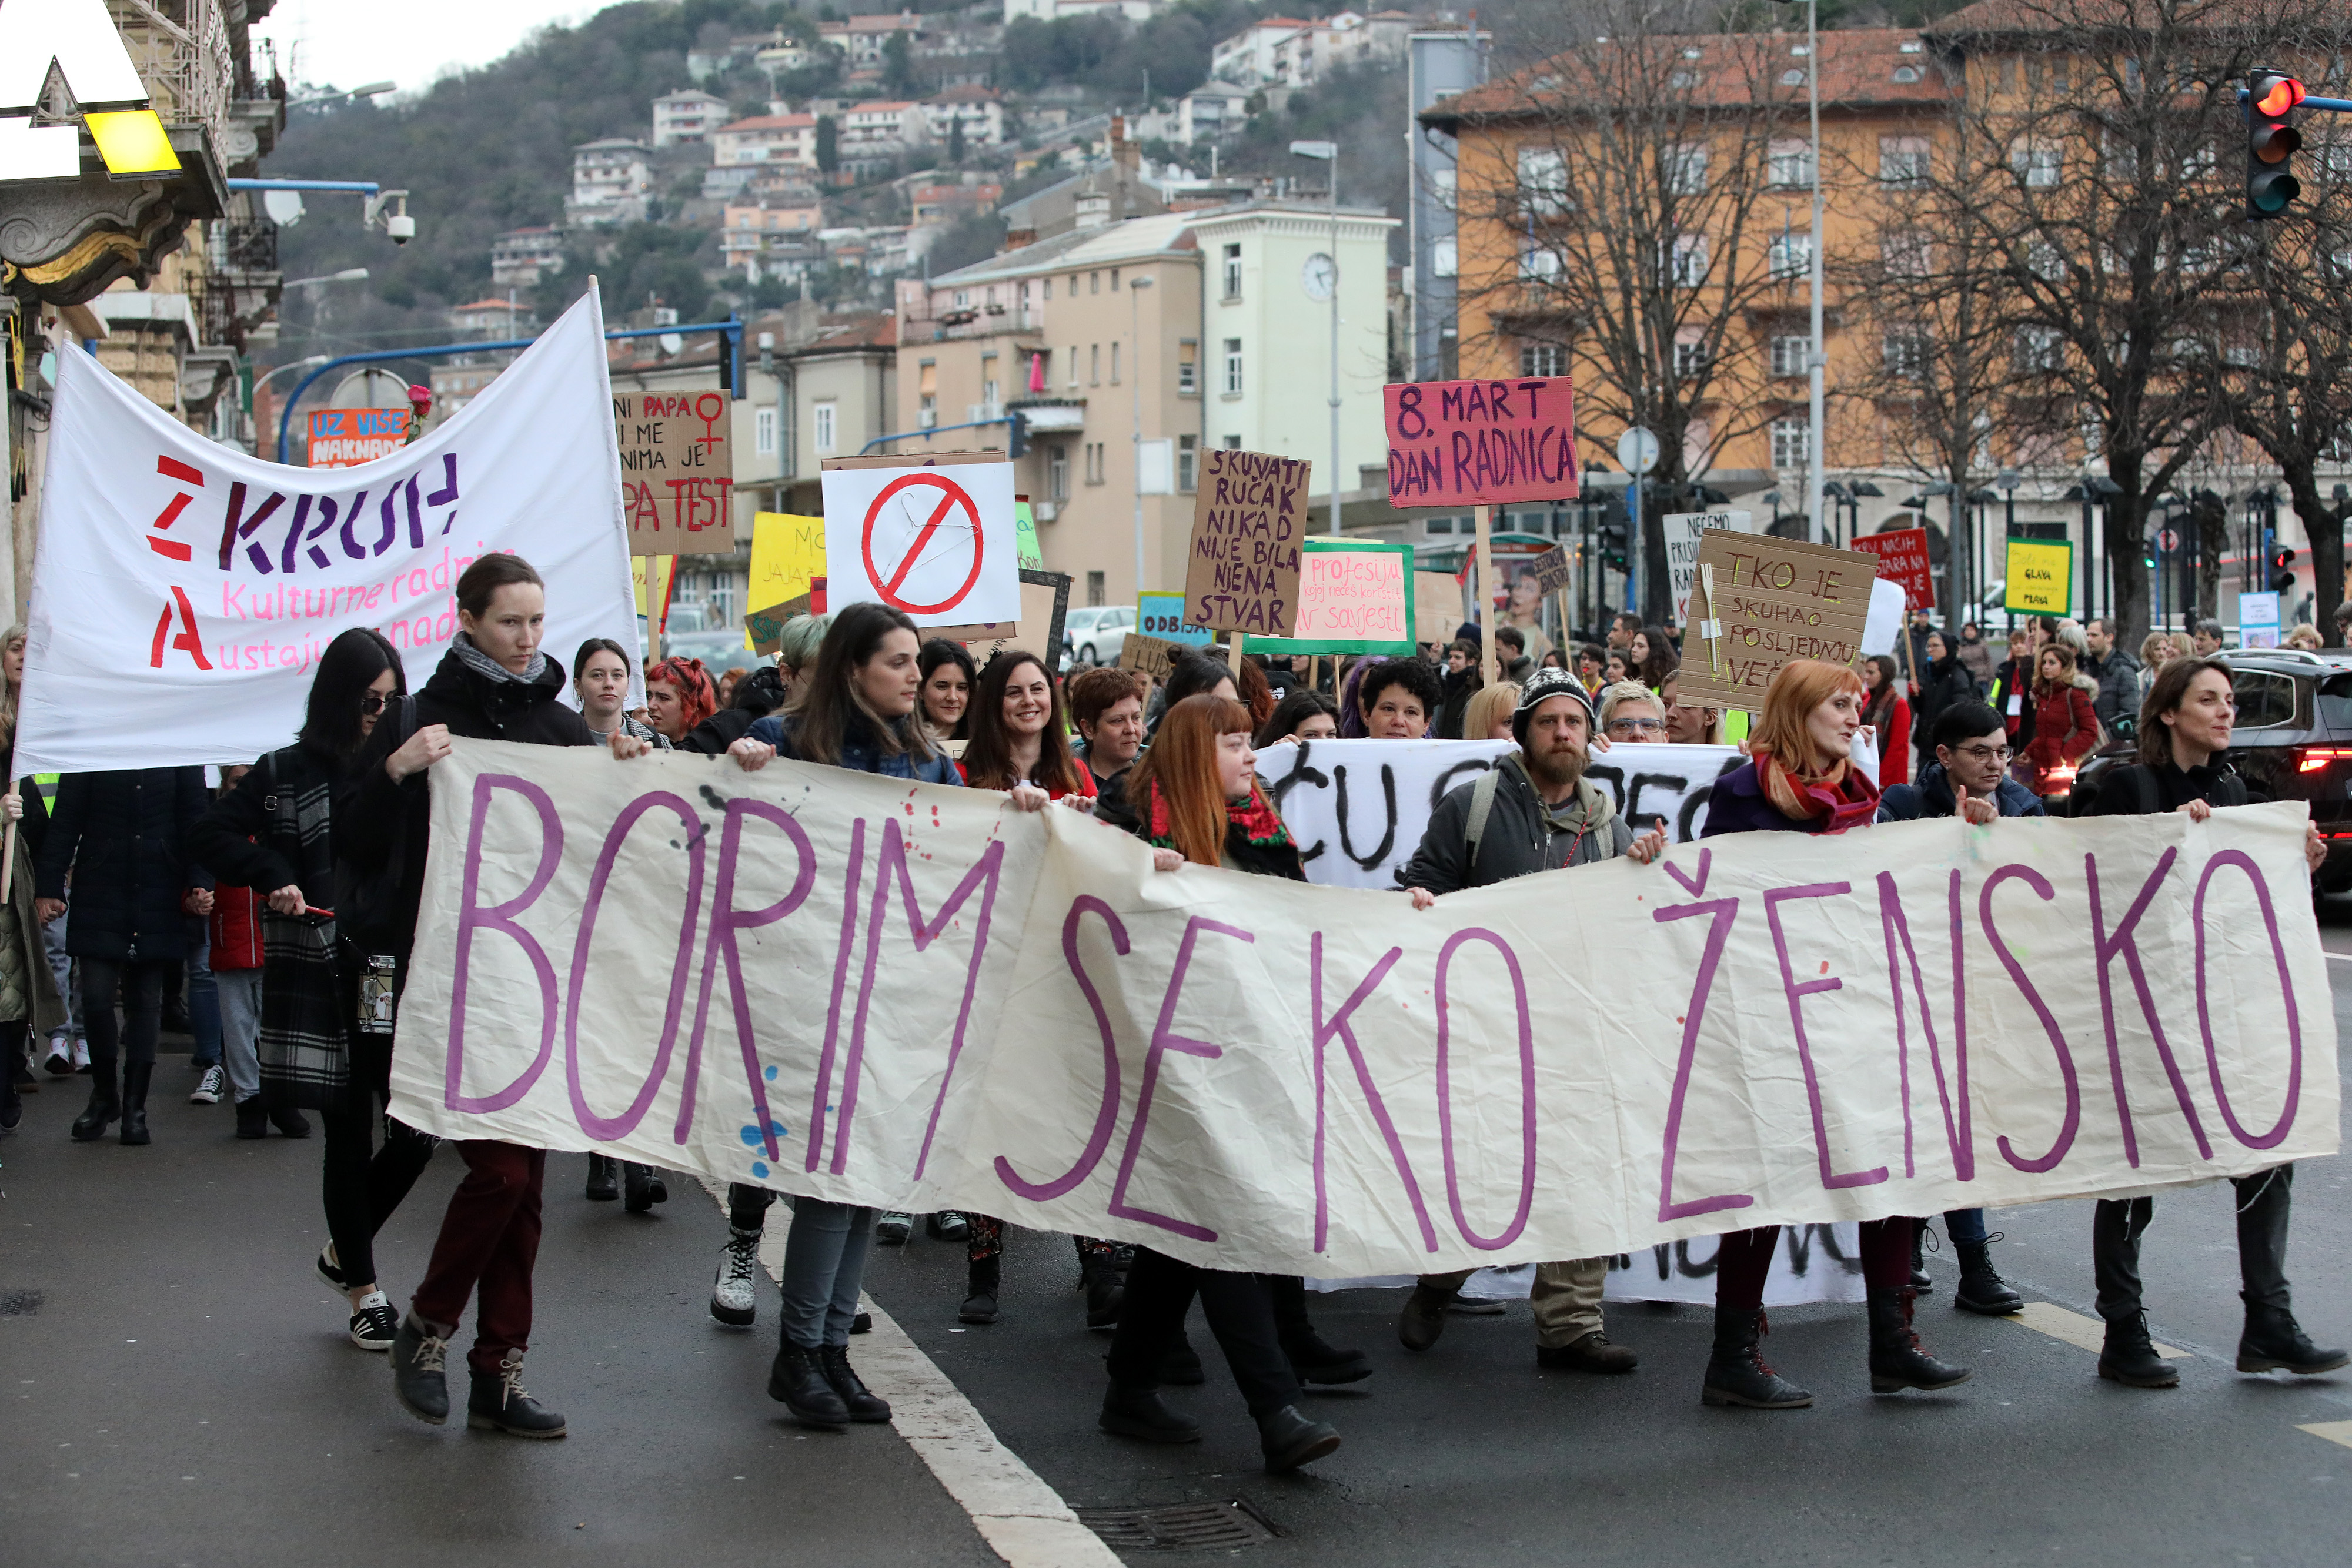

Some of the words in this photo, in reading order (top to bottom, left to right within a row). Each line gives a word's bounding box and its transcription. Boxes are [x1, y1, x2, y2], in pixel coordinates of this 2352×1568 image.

[313, 413, 345, 438] UZ
[356, 409, 405, 436] VIŠE
[643, 396, 691, 419] PAPA
[1397, 385, 1434, 441] 8.
[1442, 381, 1547, 423] MART
[637, 422, 664, 444] ME
[620, 448, 667, 470] NIMA
[681, 444, 706, 467] JE
[1208, 450, 1307, 489] SKUVATI
[1389, 446, 1443, 497] DAN
[1452, 425, 1576, 494] RADNICA
[622, 479, 660, 532] PA
[664, 477, 734, 531] TEST
[1215, 474, 1297, 515] RUČAK
[219, 452, 459, 575] KRUH
[1207, 508, 1292, 542] NIKAD
[794, 525, 826, 557] MO
[1196, 535, 1242, 561] NIJE
[1254, 540, 1299, 573] BILA
[1882, 534, 1917, 553] NAŠIH
[762, 560, 827, 590] JAJAŠ
[1214, 561, 1278, 597] NJENA
[1312, 556, 1402, 590] profesiju
[1674, 567, 1695, 591] RAD
[1725, 551, 1796, 590] TKO
[1810, 569, 1843, 602] JE
[223, 579, 386, 621] Kulturne
[1303, 581, 1325, 603] kojoj
[1195, 594, 1285, 633] STVAR
[1324, 603, 1402, 636] savjesti
[1731, 597, 1822, 627] SKUHAO
[1730, 624, 1857, 665] POSLJEDNJU
[1726, 658, 1783, 693] VEČ
[443, 773, 1005, 1181] BORIM
[993, 894, 1255, 1242] SE
[1311, 926, 1537, 1253] KO
[1653, 845, 2301, 1222] ŽENSKO
